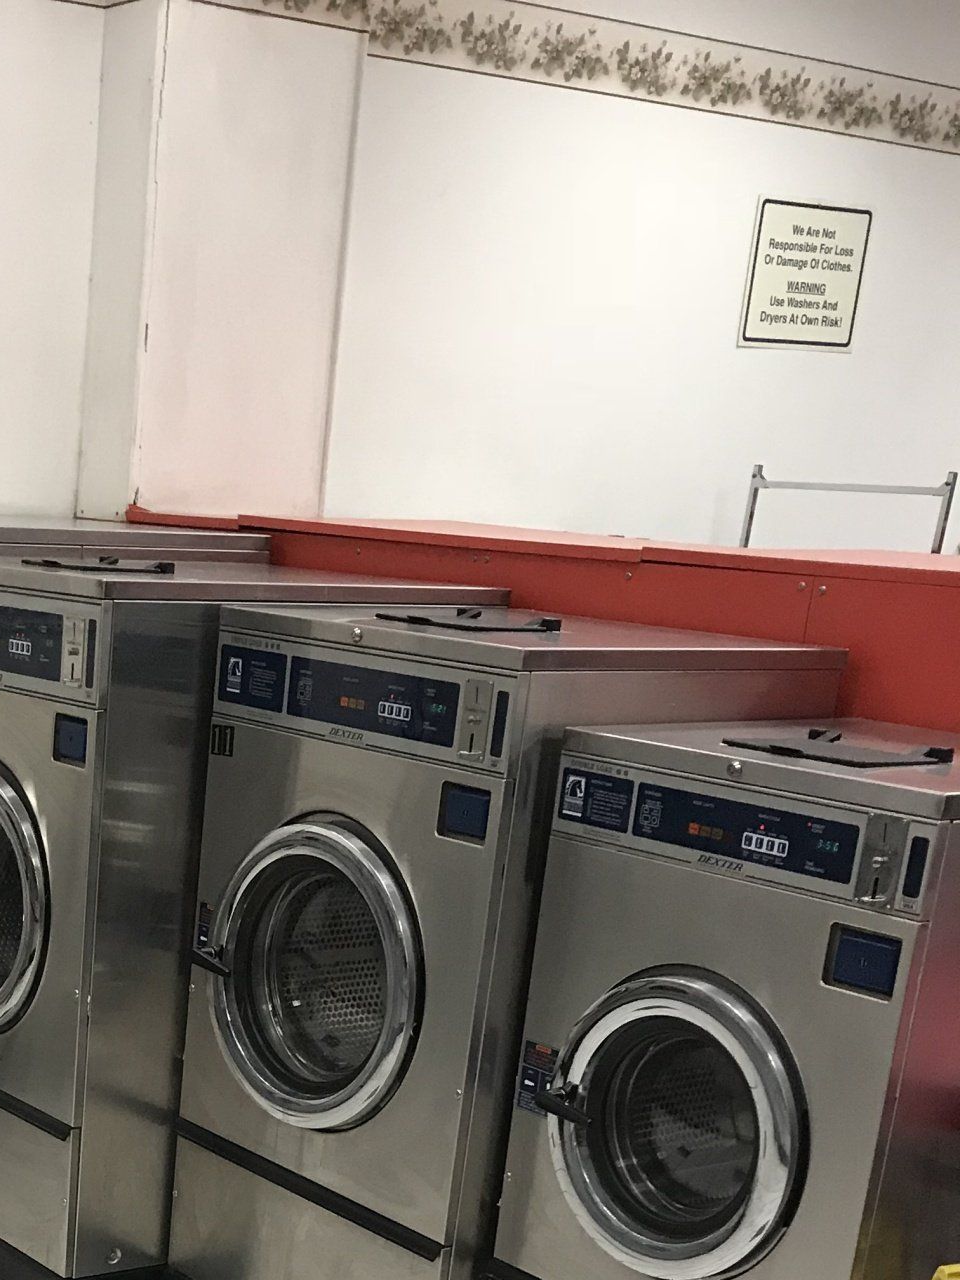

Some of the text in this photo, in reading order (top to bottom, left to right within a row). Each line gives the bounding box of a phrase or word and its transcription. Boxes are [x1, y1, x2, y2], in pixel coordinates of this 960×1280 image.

[792, 224, 836, 239] We Are Not
[769, 238, 854, 257] Responsible For Loss
[764, 254, 853, 273] Or Damage Of Clothes.
[787, 280, 827, 295] WARNING
[770, 295, 839, 312] Use Washers And
[760, 311, 843, 328] Dryers At Own Risk!
[329, 727, 364, 741] DEXTER
[697, 854, 744, 872] DEXTER
